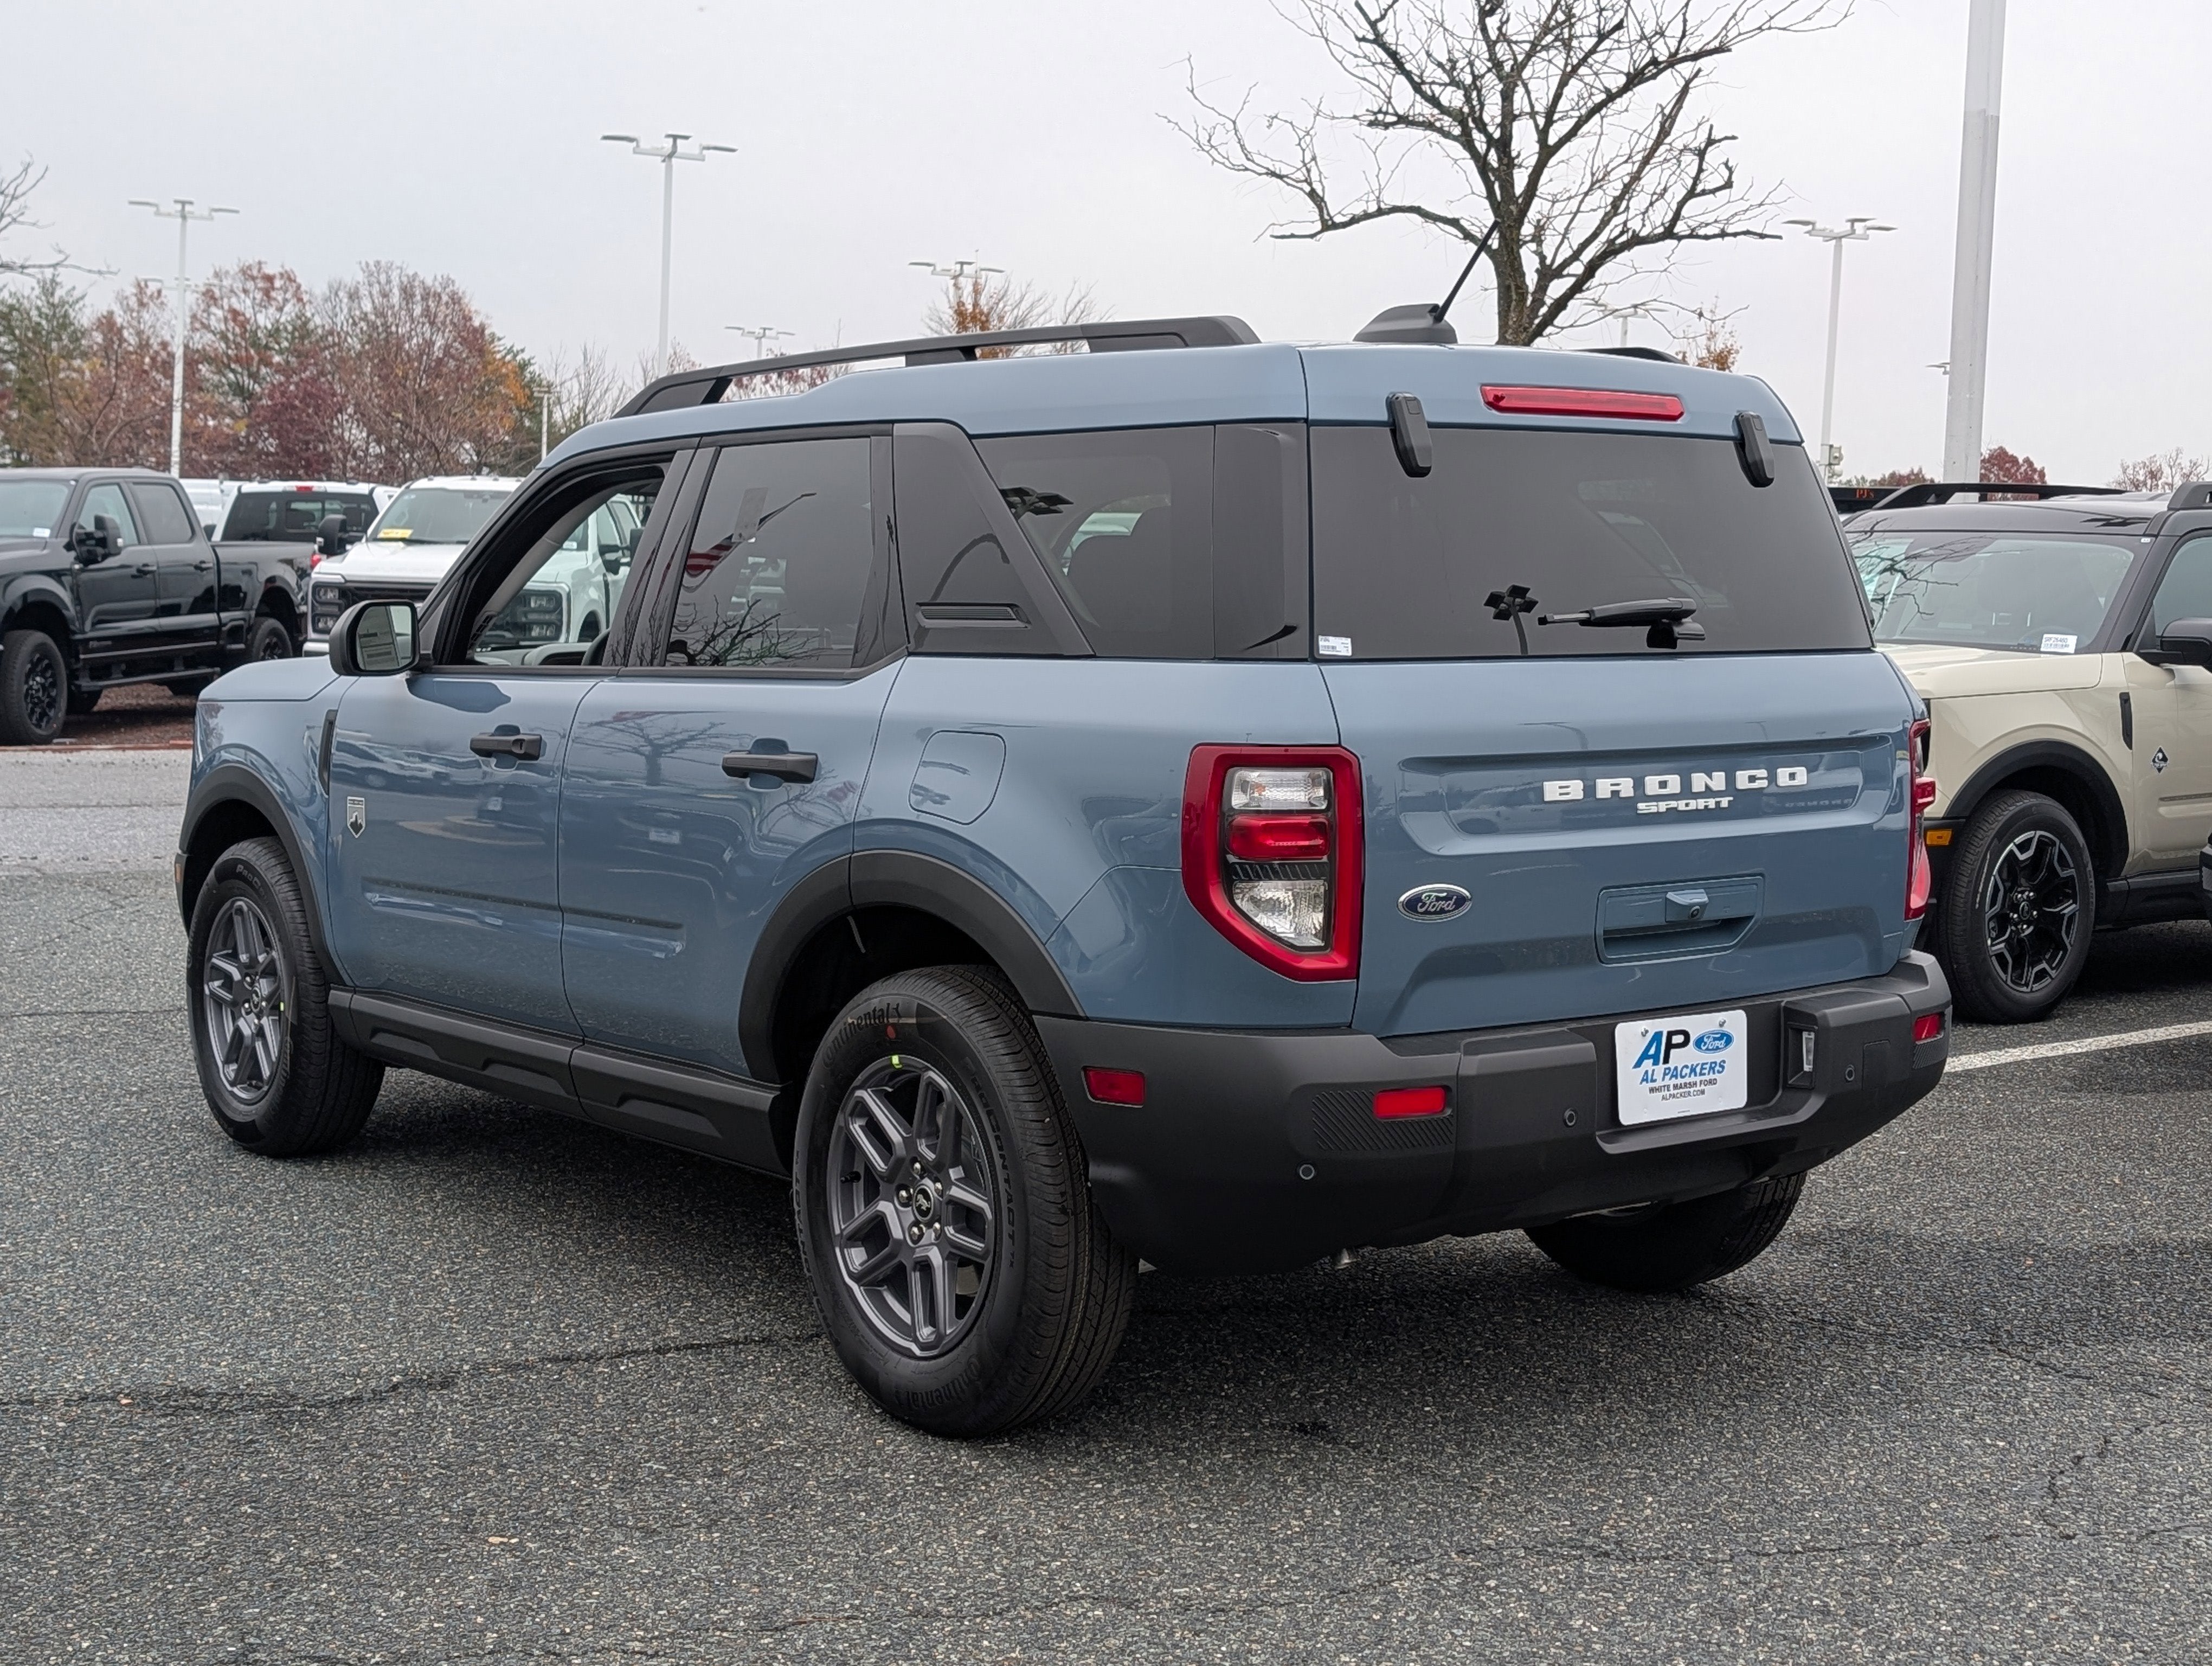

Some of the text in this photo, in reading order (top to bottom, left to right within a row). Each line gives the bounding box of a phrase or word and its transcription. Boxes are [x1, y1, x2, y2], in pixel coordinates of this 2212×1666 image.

[1542, 766, 1808, 802] BRONCO
[1636, 796, 1734, 814] SPORT
[1417, 892, 1457, 913] Ford
[1631, 1029, 1727, 1069] AP Ford
[1639, 1059, 1727, 1085] AL PACKERS
[1648, 1078, 1718, 1095] WHITE MARSH FORD
[1661, 1088, 1706, 1102] ALPACKER.COM
